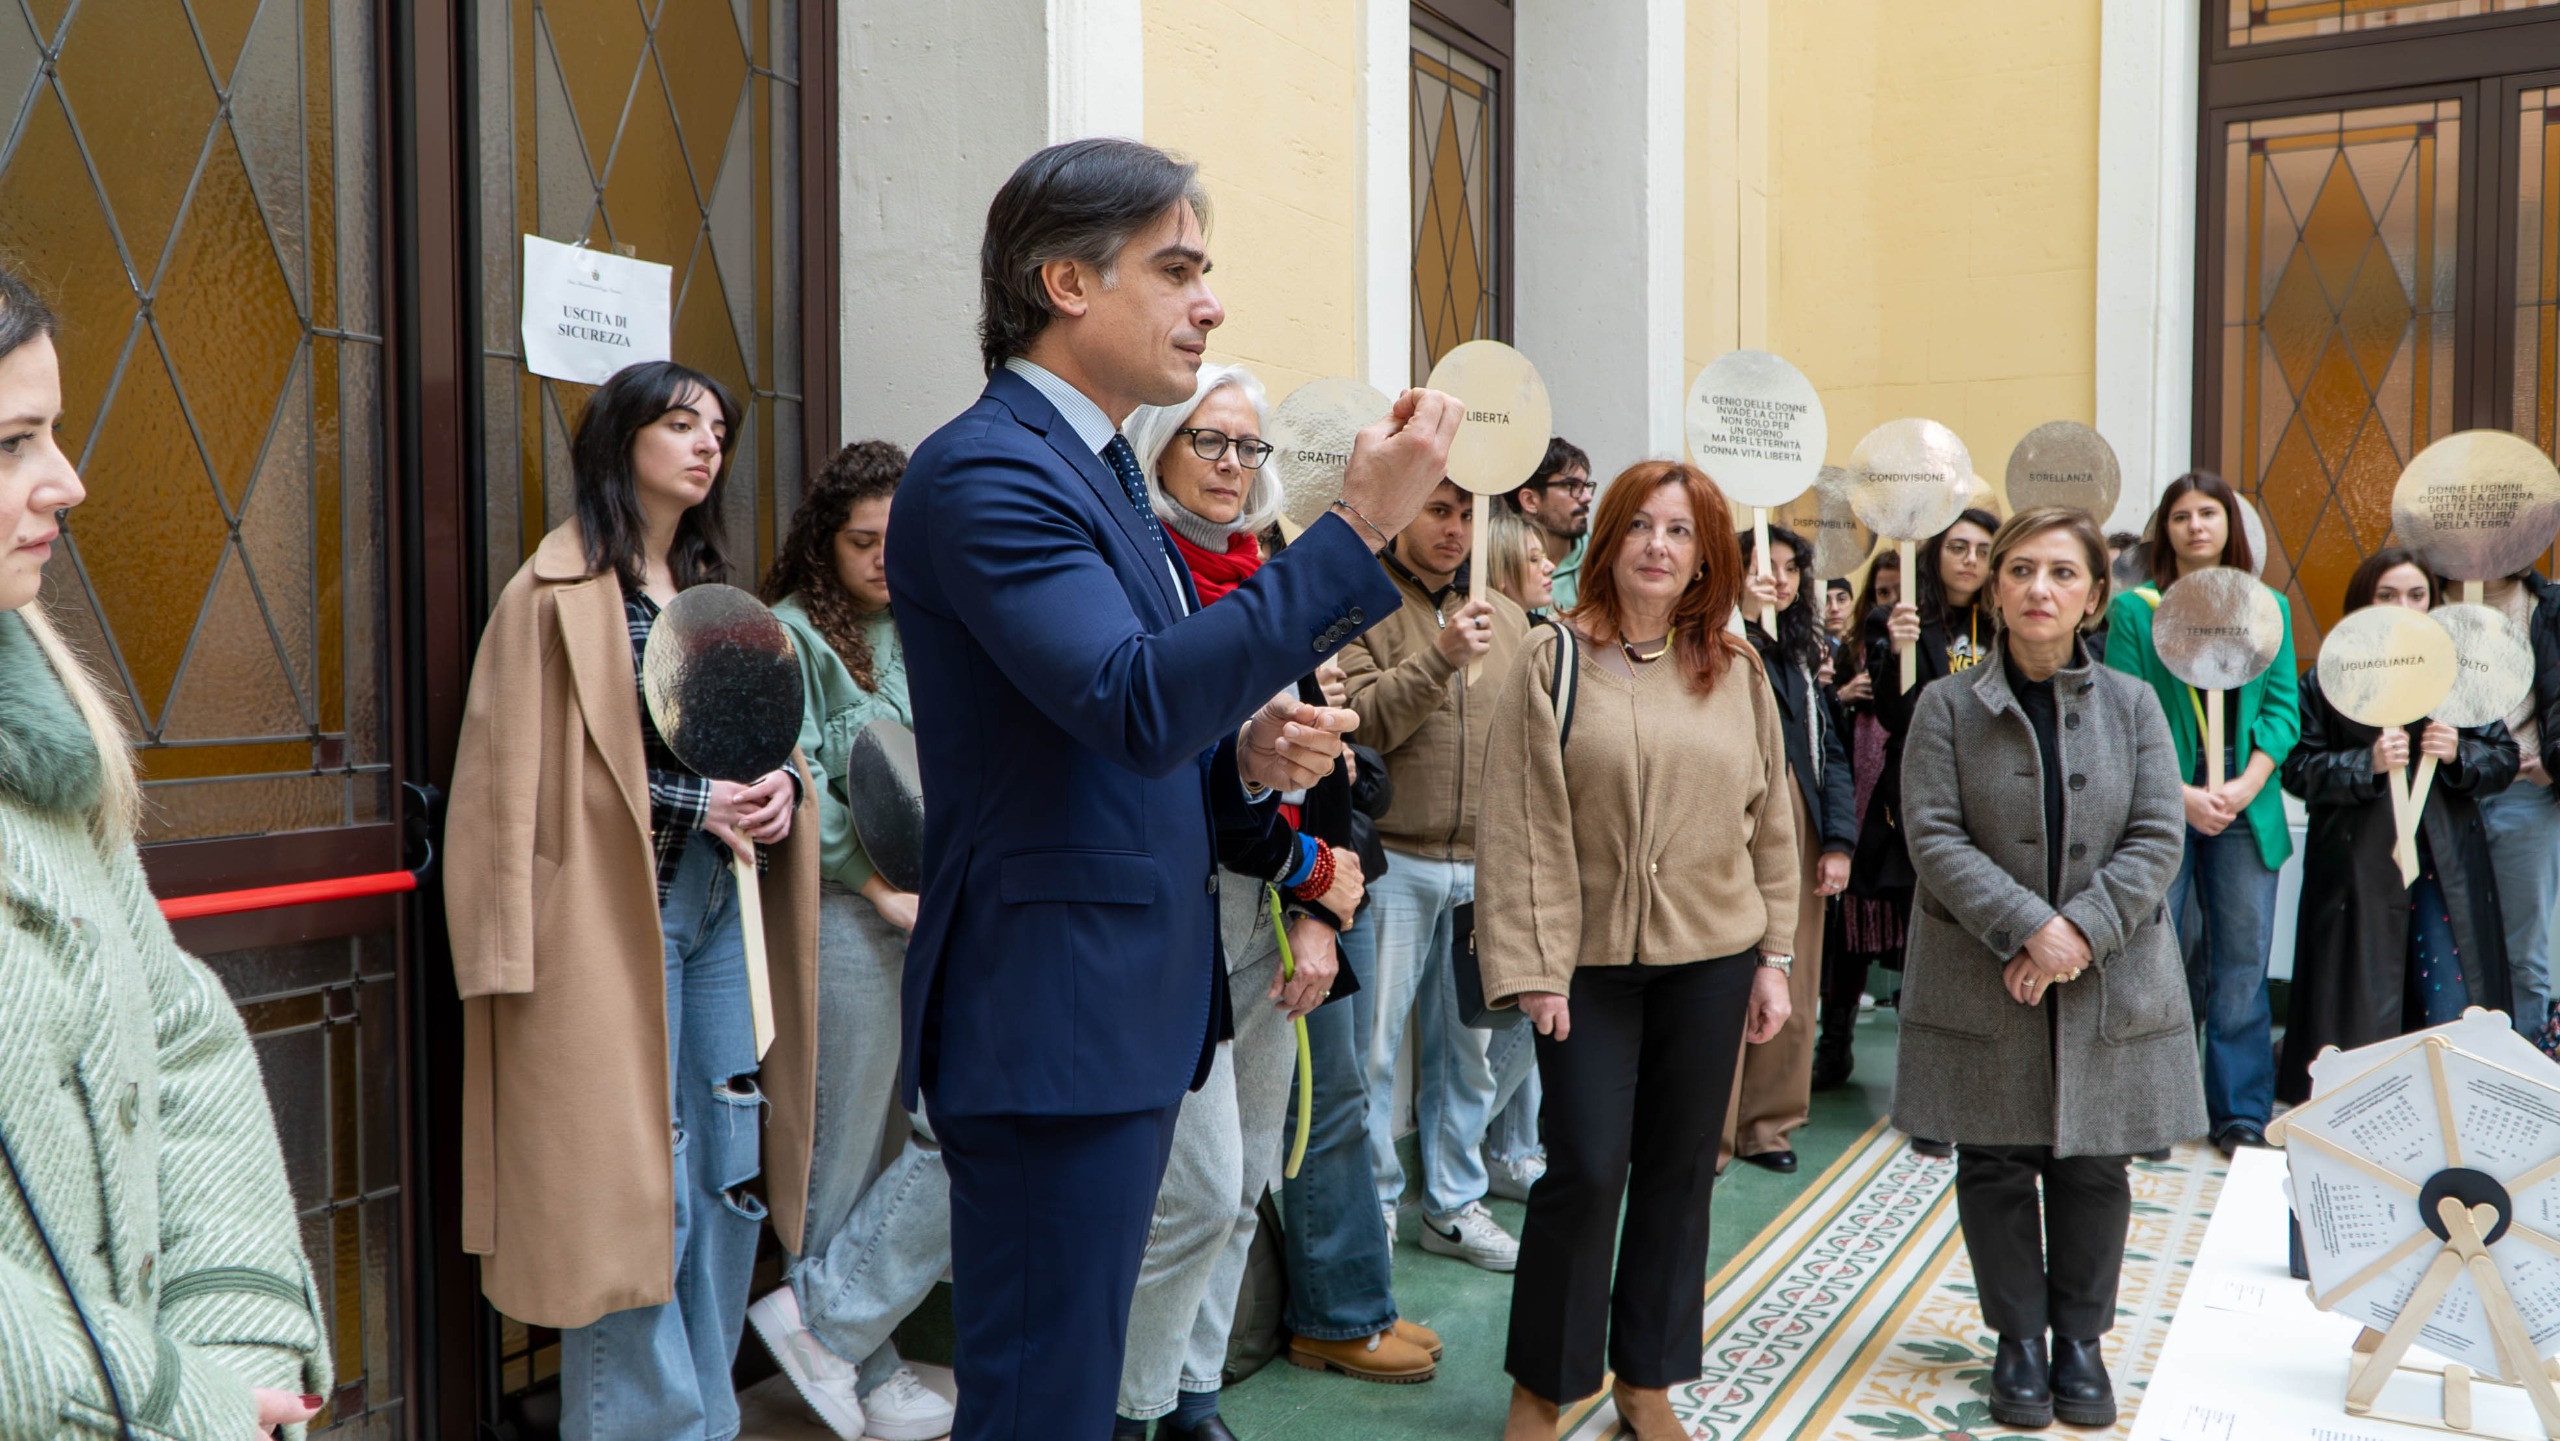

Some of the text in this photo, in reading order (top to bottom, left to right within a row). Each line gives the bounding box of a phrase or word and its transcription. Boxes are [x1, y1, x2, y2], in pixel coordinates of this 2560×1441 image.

[563, 305, 627, 329] USCITA DI
[557, 323, 631, 348] SICUREZZA
[1701, 395, 1808, 414] IL GENIO DELLE DONNE
[1717, 406, 1752, 418] INVADE
[1754, 410, 1766, 418] LA
[1721, 416, 1789, 430] NON SOLO PER
[1730, 426, 1783, 439] UN GIORNO
[1711, 434, 1726, 443] MA
[1729, 436, 1747, 445] PER
[1703, 445, 1802, 462] DONNA VITA LIBERTÀ
[1868, 473, 1946, 483] CONDIVISIONE
[2029, 472, 2094, 483] SORELLANZA
[2428, 483, 2523, 495] DONNE E UOMINI
[2419, 493, 2534, 504] CONTRO LA GUERRA
[2429, 502, 2519, 513] LOTTA COMUNE
[2433, 511, 2515, 521] PER IL FUTURO
[2434, 520, 2511, 530] DELLA TERRA
[2186, 627, 2249, 637] TENEREZZA
[2341, 655, 2425, 672] UGUAGLIANZA
